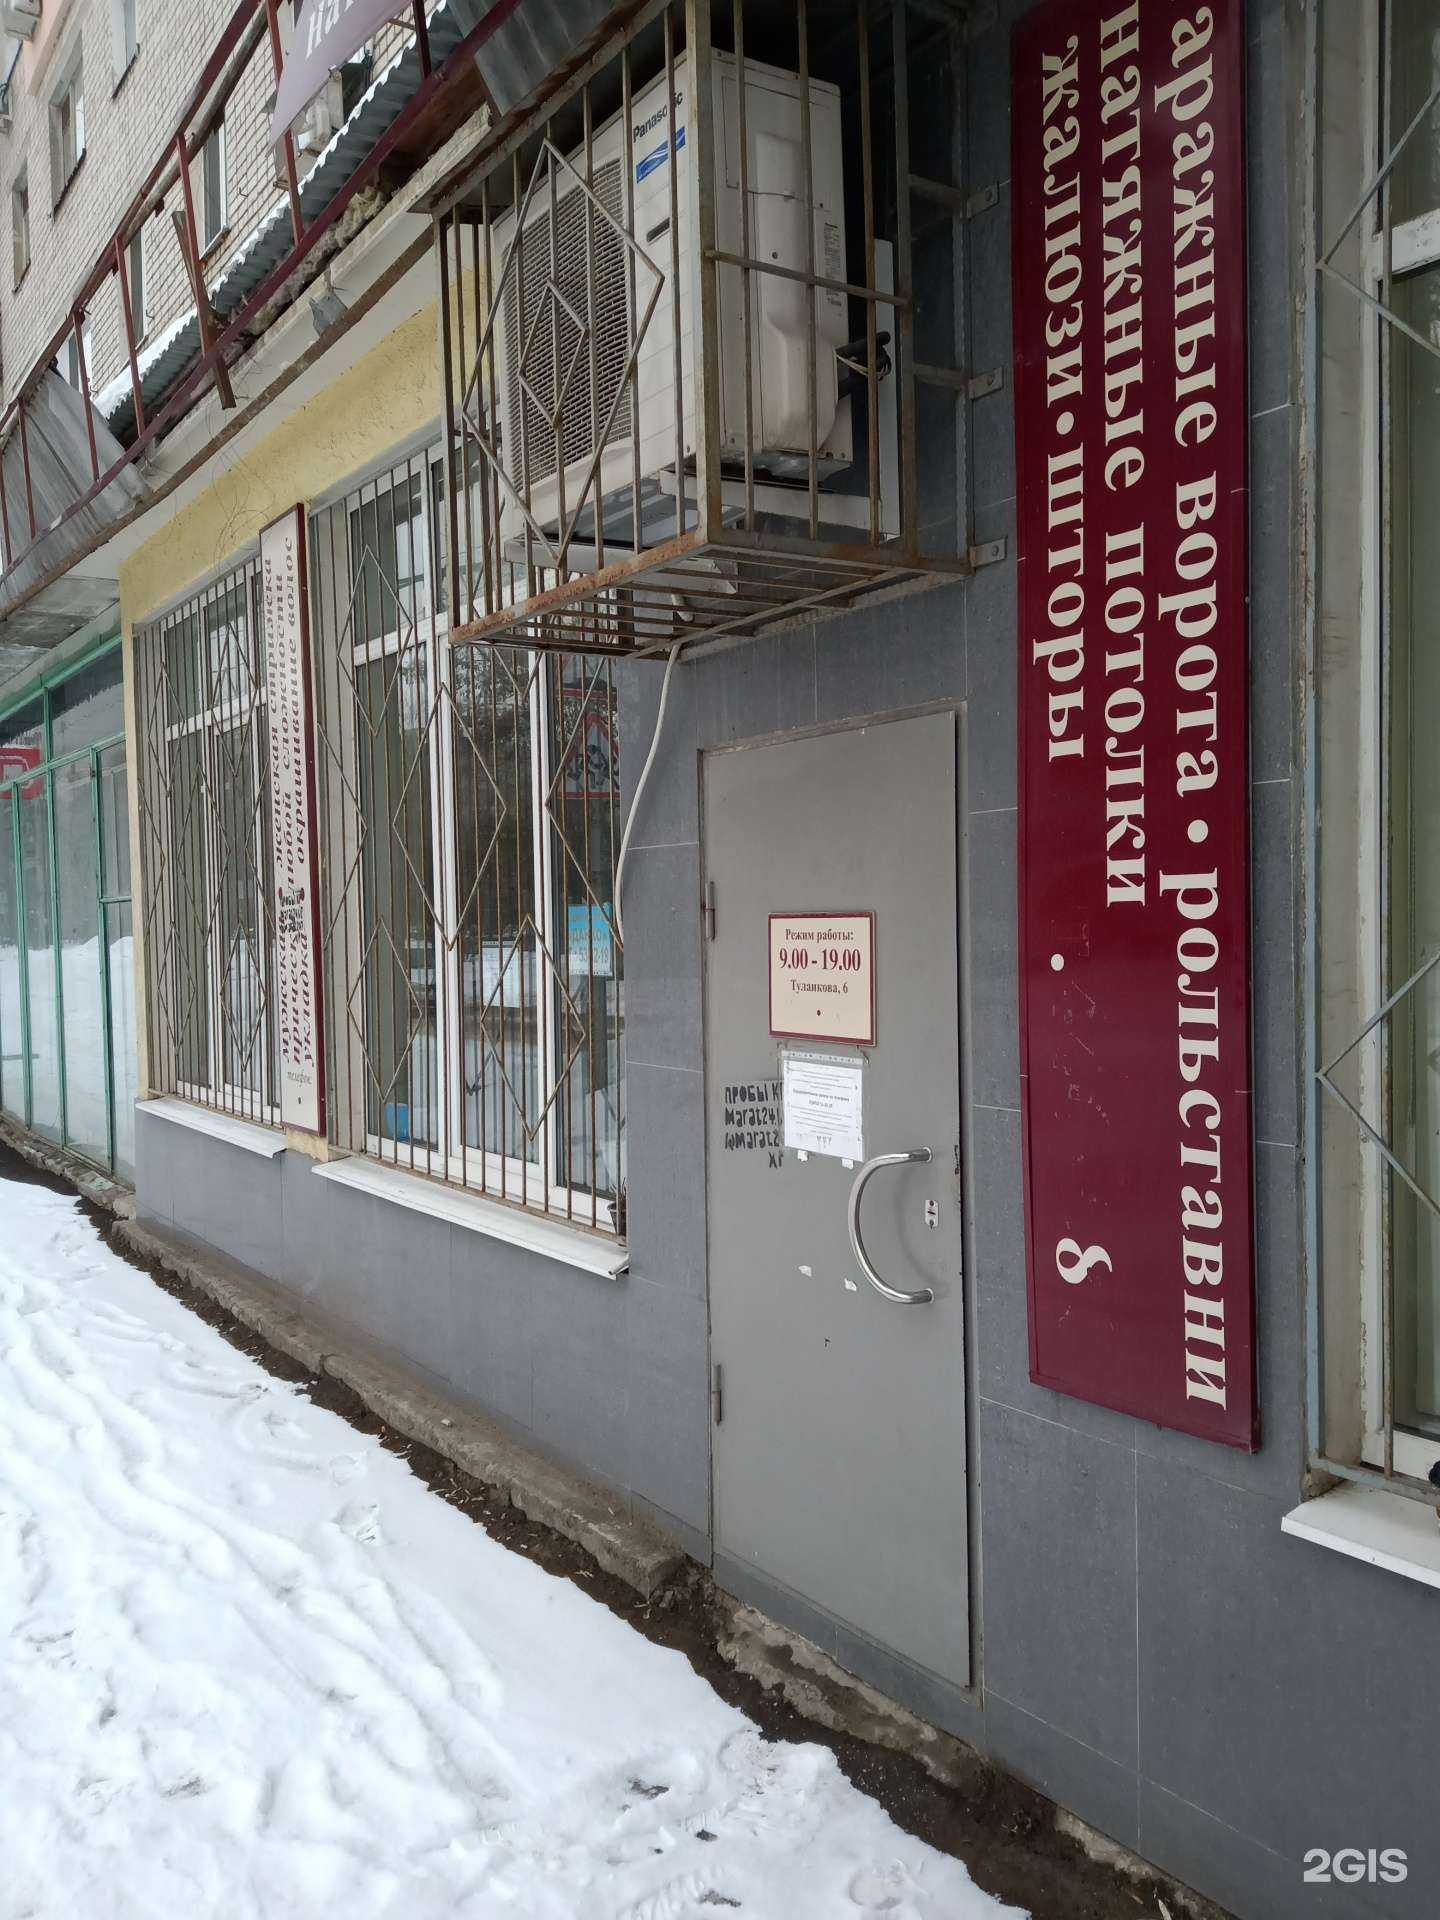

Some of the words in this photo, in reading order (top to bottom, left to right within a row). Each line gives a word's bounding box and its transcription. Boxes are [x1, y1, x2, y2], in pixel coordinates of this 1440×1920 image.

[1042, 35, 1083, 408] жалюзи
[1101, 0, 1146, 492] натяжные
[1154, 0, 1217, 448] аражные
[264, 559, 278, 714] стрижка
[276, 575, 290, 770] сложности
[285, 536, 296, 627] волос
[1033, 442, 1085, 762] шторы
[1158, 471, 1218, 798] ворота
[289, 638, 306, 865] окрашивание
[1104, 521, 1146, 907] потолки
[299, 932, 315, 1068] укладка
[779, 948, 808, 969] 9.00
[821, 948, 861, 971] 19.00
[785, 928, 814, 941] Режим
[817, 928, 854, 943] работы:
[842, 982, 848, 993] 6
[1159, 867, 1227, 1411] рольставни
